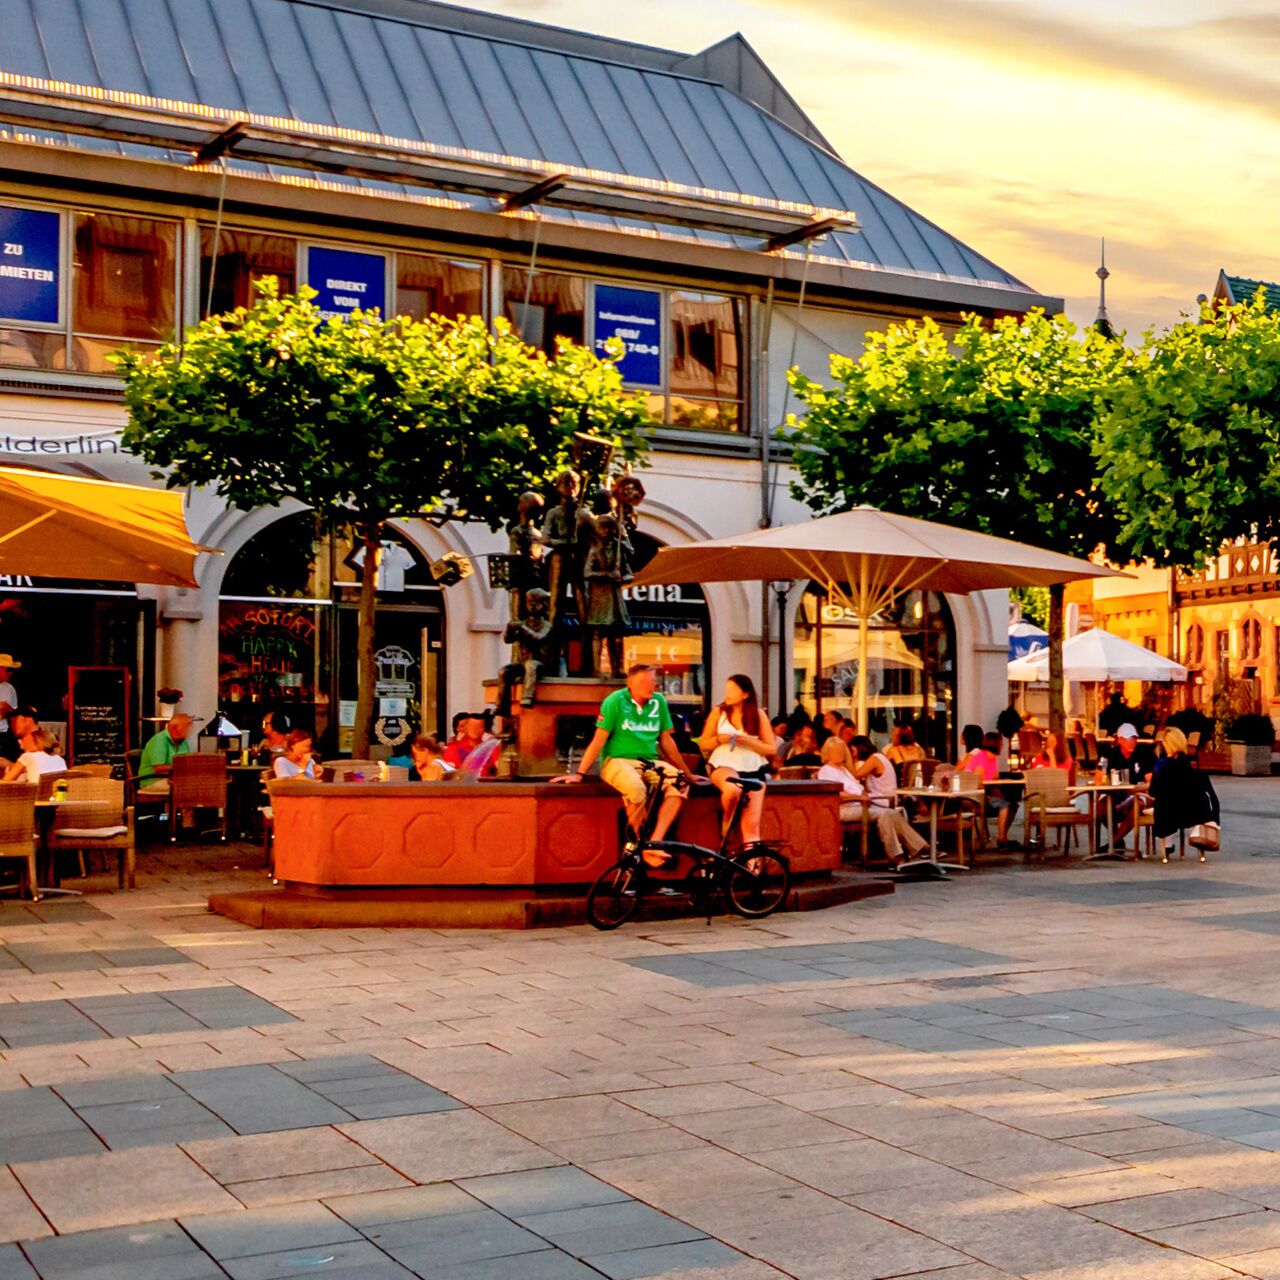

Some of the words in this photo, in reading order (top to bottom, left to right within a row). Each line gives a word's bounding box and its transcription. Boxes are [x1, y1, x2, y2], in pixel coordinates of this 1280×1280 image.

[4, 243, 23, 255] ZU
[326, 278, 367, 293] DIREKT
[333, 295, 360, 308] VOM
[648, 699, 659, 718] 2
